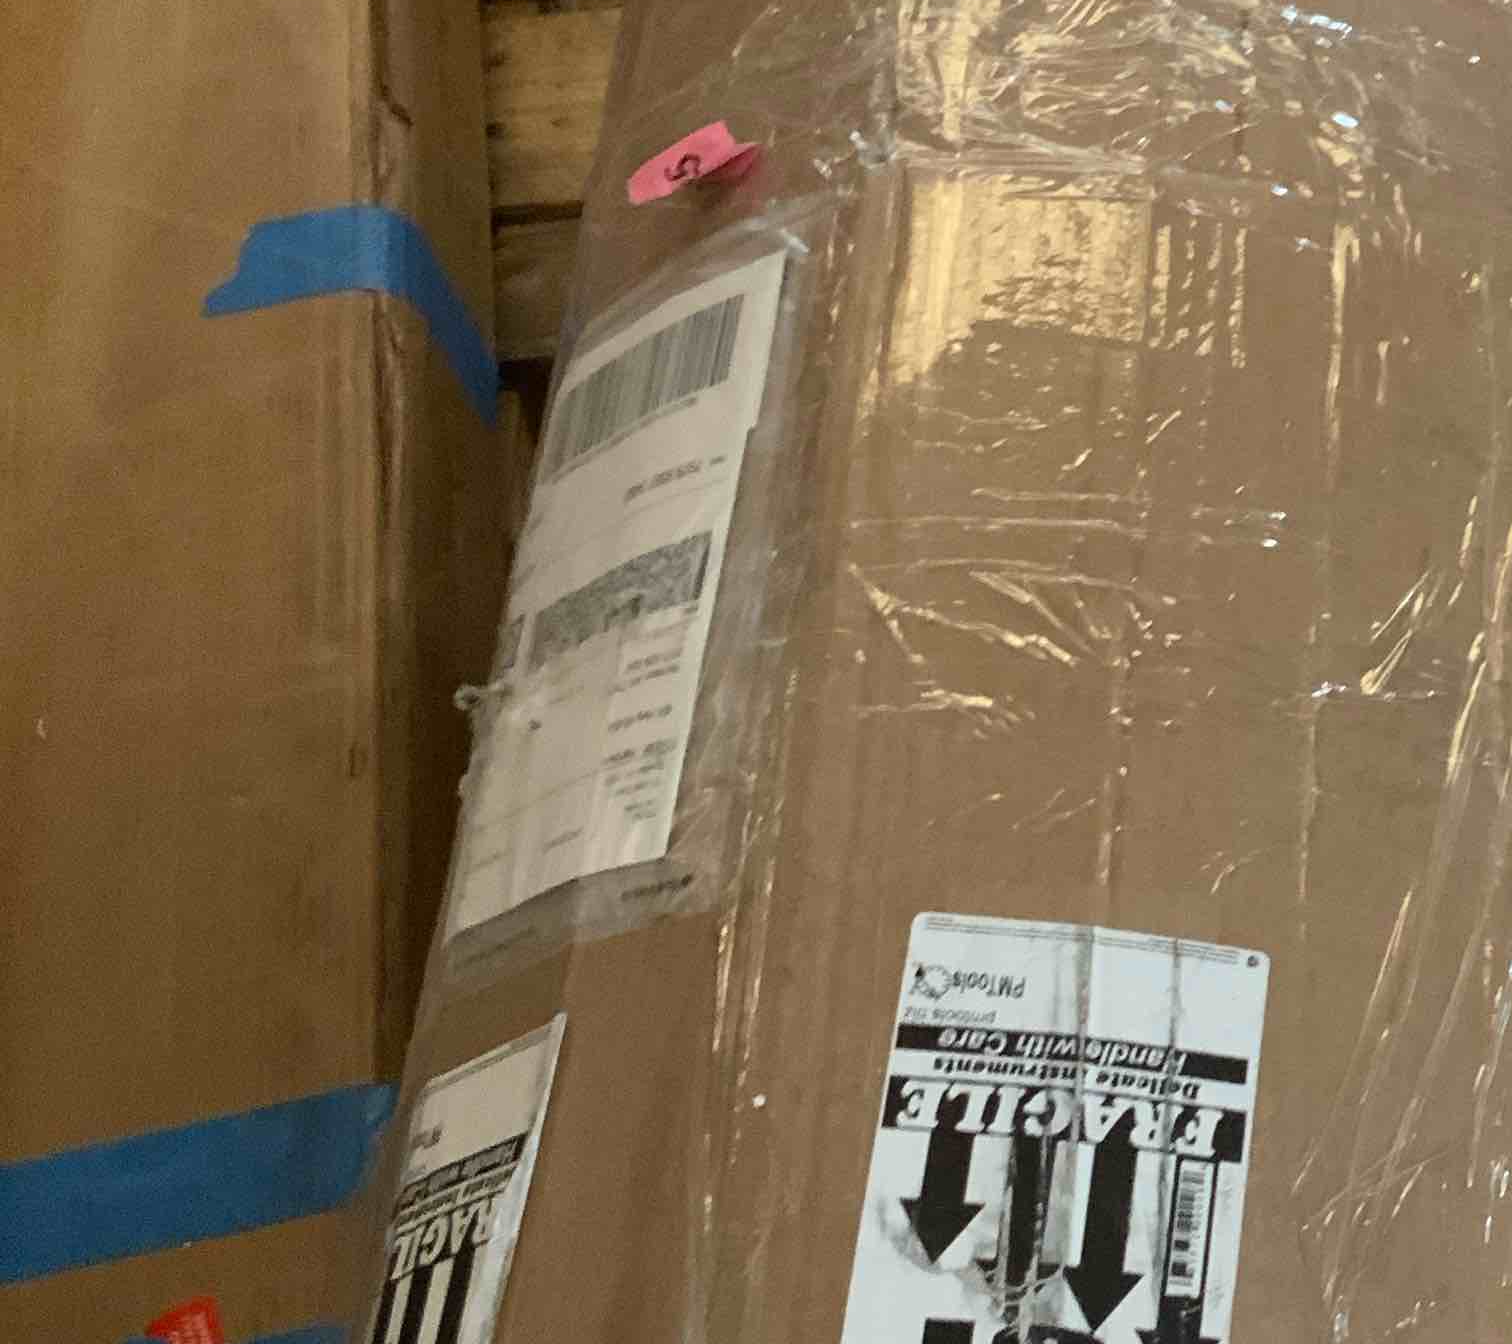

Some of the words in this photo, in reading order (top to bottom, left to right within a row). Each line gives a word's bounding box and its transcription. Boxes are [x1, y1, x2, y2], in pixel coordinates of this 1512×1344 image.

[951, 970, 1026, 1001] PMTools
[936, 1028, 1008, 1058] Care
[1015, 1033, 1078, 1058] with
[895, 1077, 1224, 1158] FRAGILE
